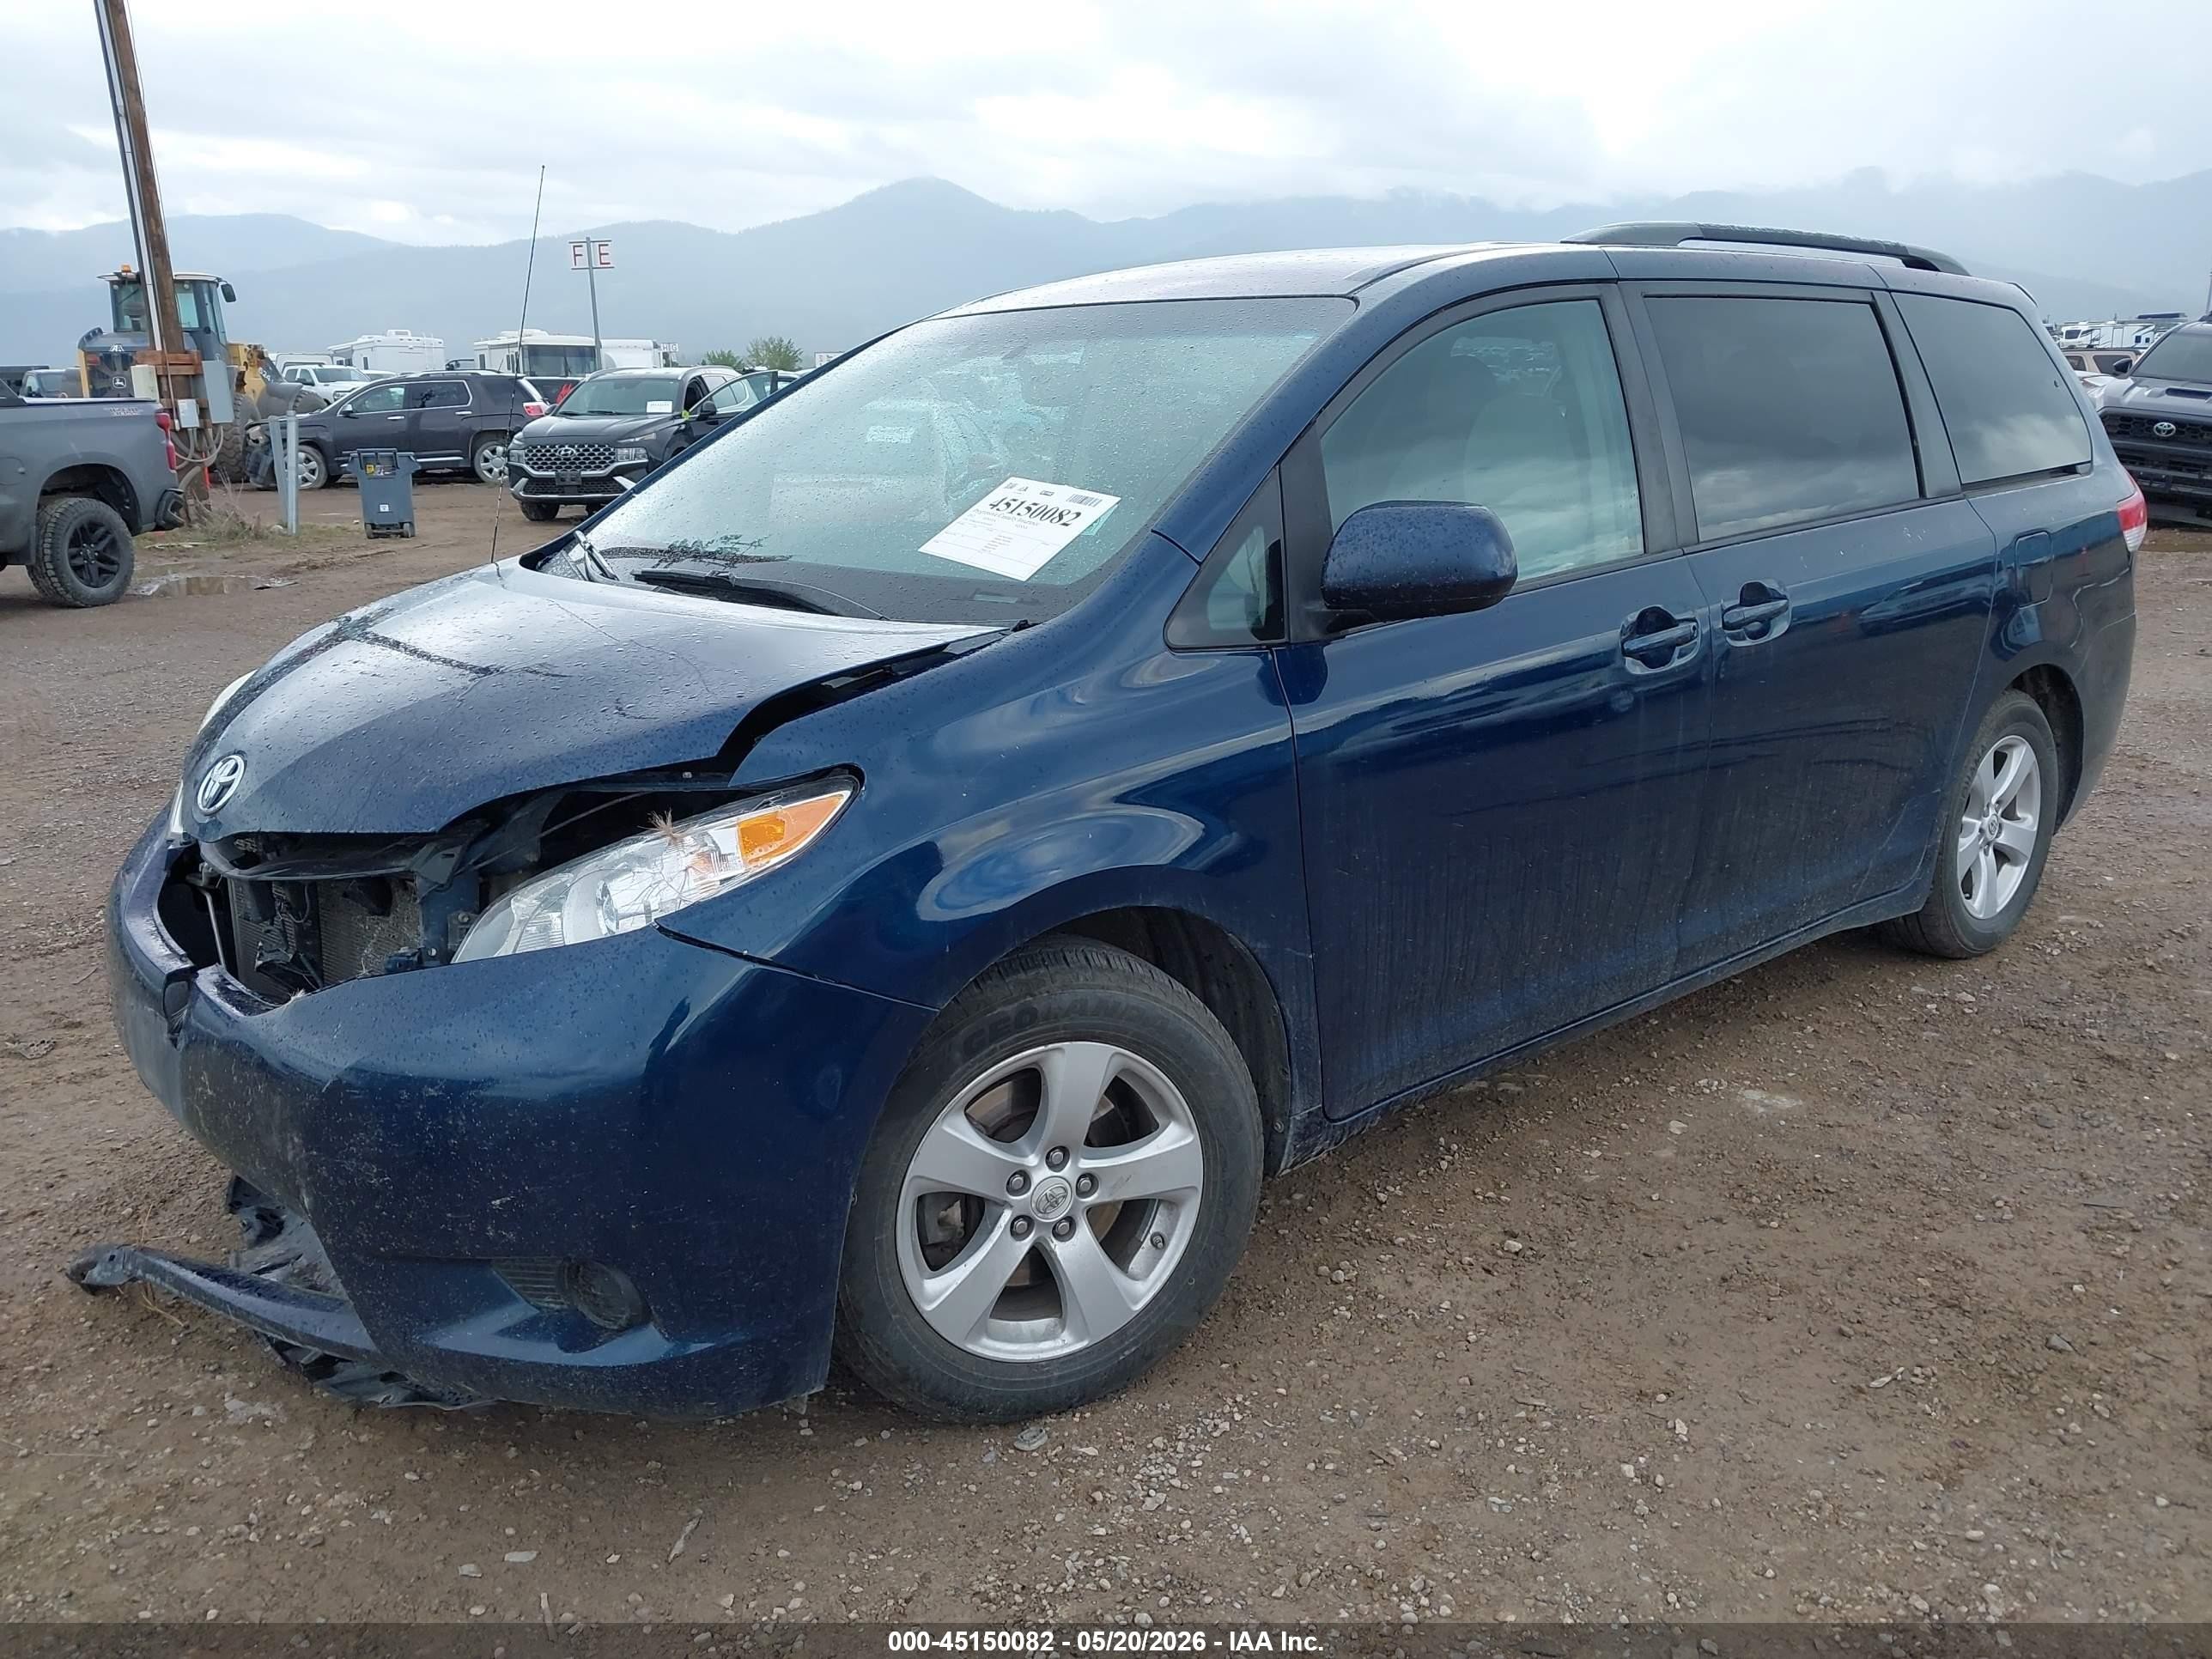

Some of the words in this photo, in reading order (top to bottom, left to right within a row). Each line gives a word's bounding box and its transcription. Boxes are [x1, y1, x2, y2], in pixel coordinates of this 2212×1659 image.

[573, 245, 583, 266] F
[599, 244, 611, 264] E
[989, 497, 1082, 527] 45150082
